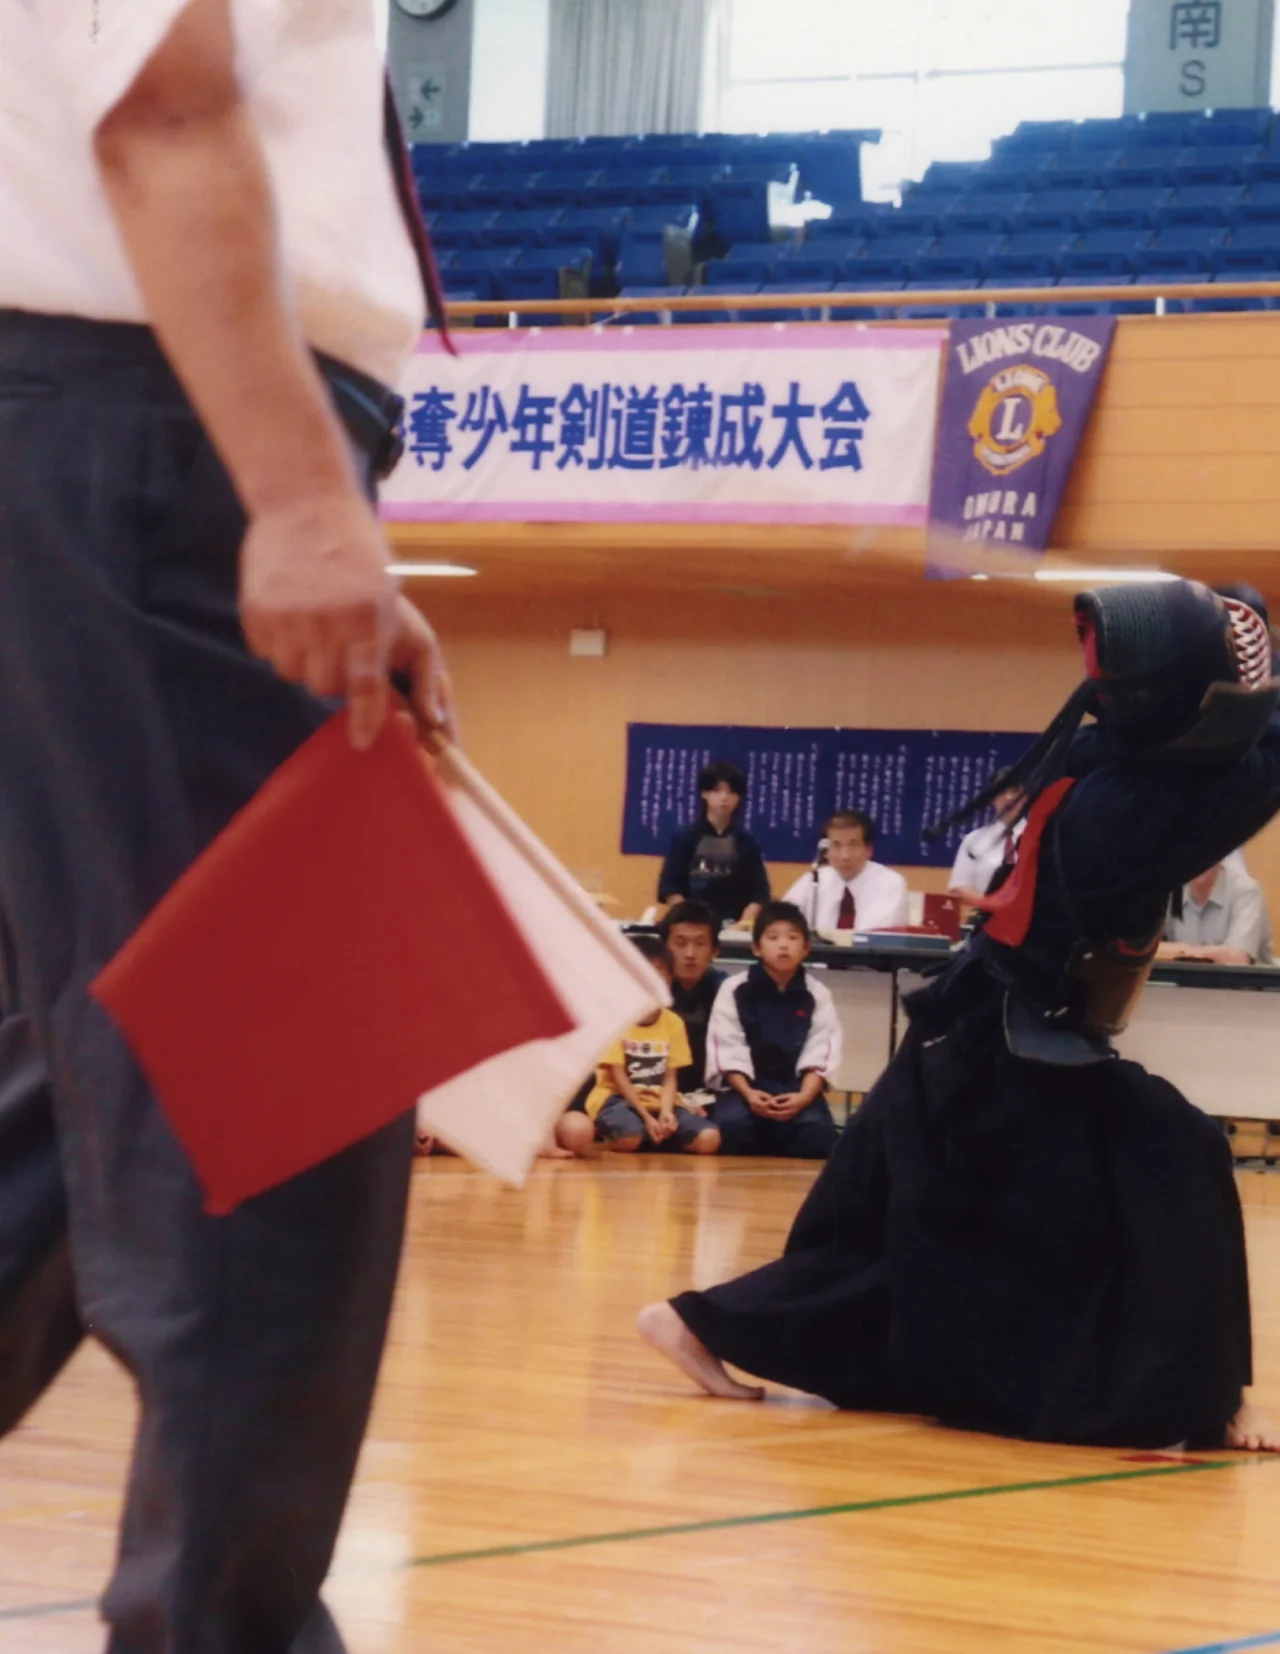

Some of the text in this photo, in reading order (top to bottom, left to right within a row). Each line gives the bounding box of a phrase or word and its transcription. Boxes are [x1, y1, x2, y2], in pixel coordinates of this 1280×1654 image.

[1170, 0, 1222, 50] 南
[1179, 60, 1206, 97] S
[956, 323, 1101, 375] LIONS CLUB
[393, 380, 871, 473] 奪少年剣道錬成大会
[996, 397, 1023, 440] L
